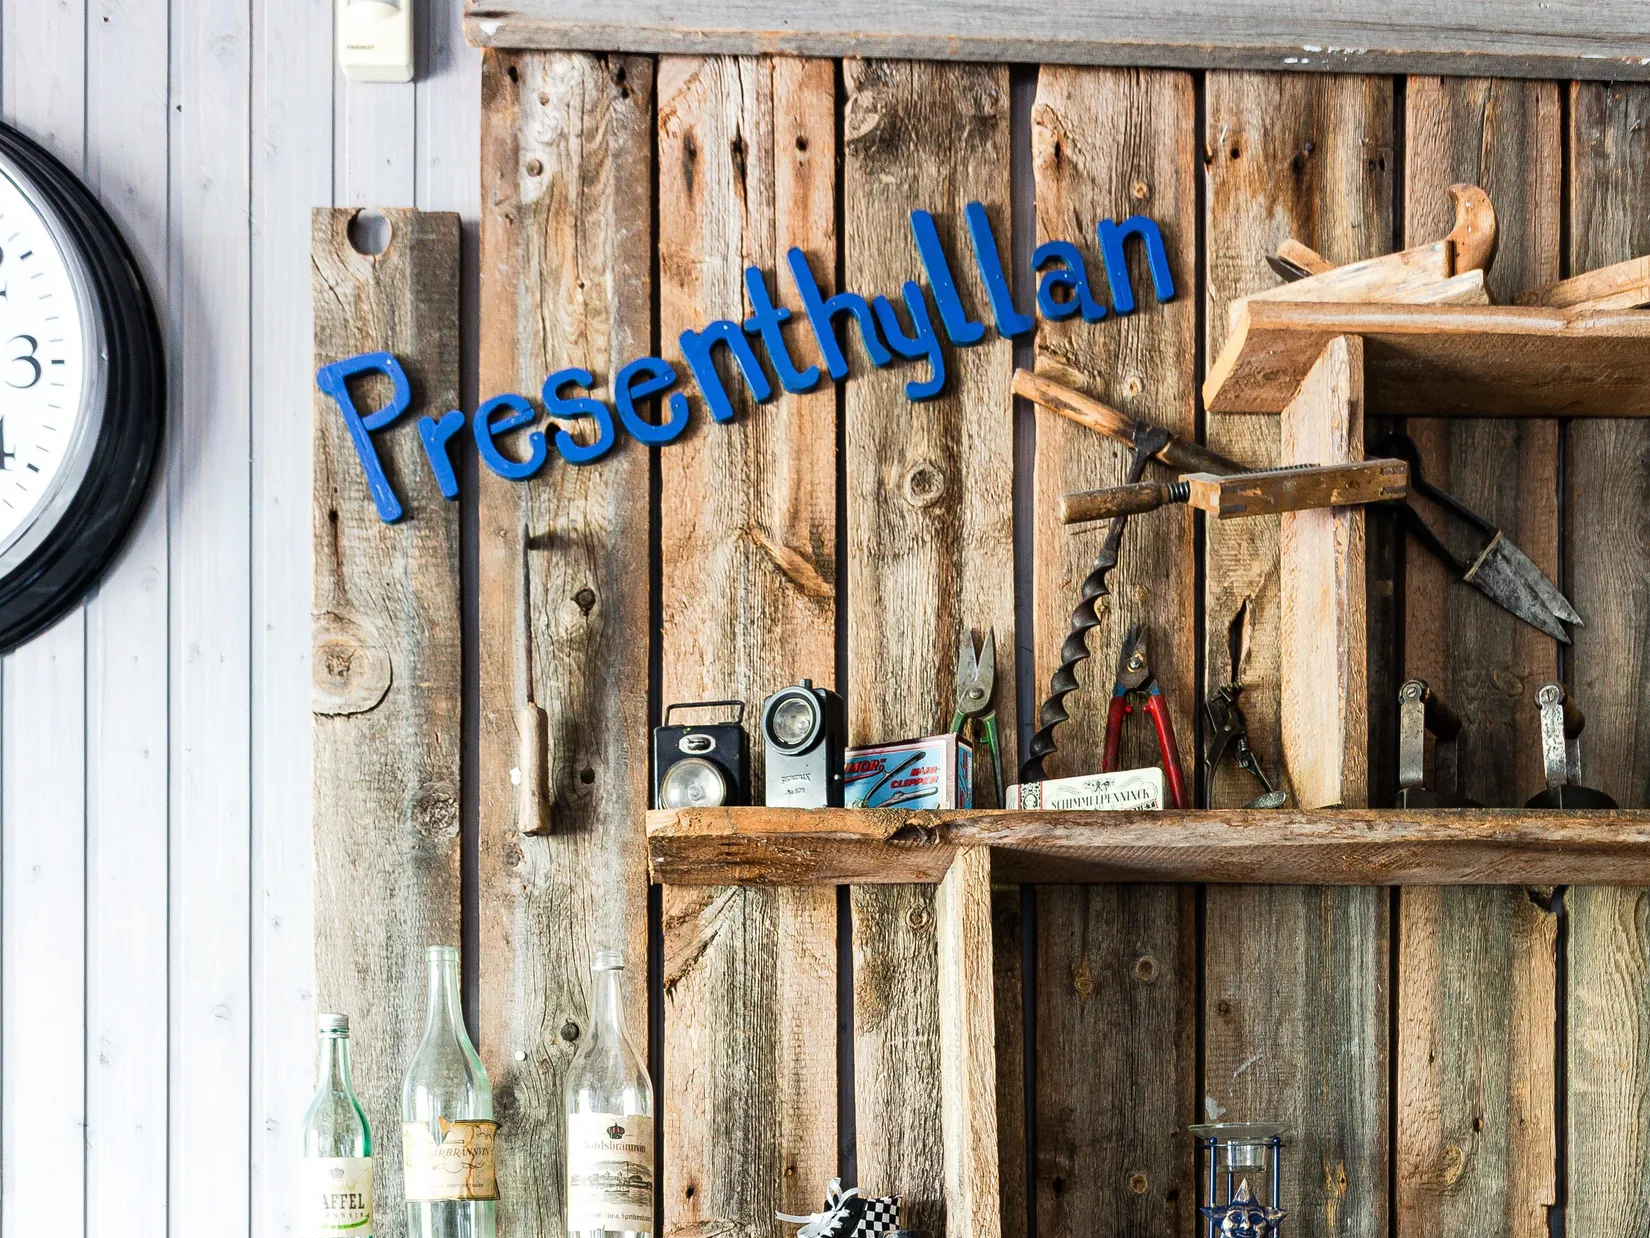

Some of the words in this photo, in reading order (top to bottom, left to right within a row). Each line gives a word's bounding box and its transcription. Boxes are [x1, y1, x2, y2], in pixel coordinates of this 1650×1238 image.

[4, 334, 42, 389] 3
[316, 201, 1175, 523] Presenthyllan
[890, 776, 938, 789] CLIPPER
[323, 1193, 365, 1210] AFFEL
